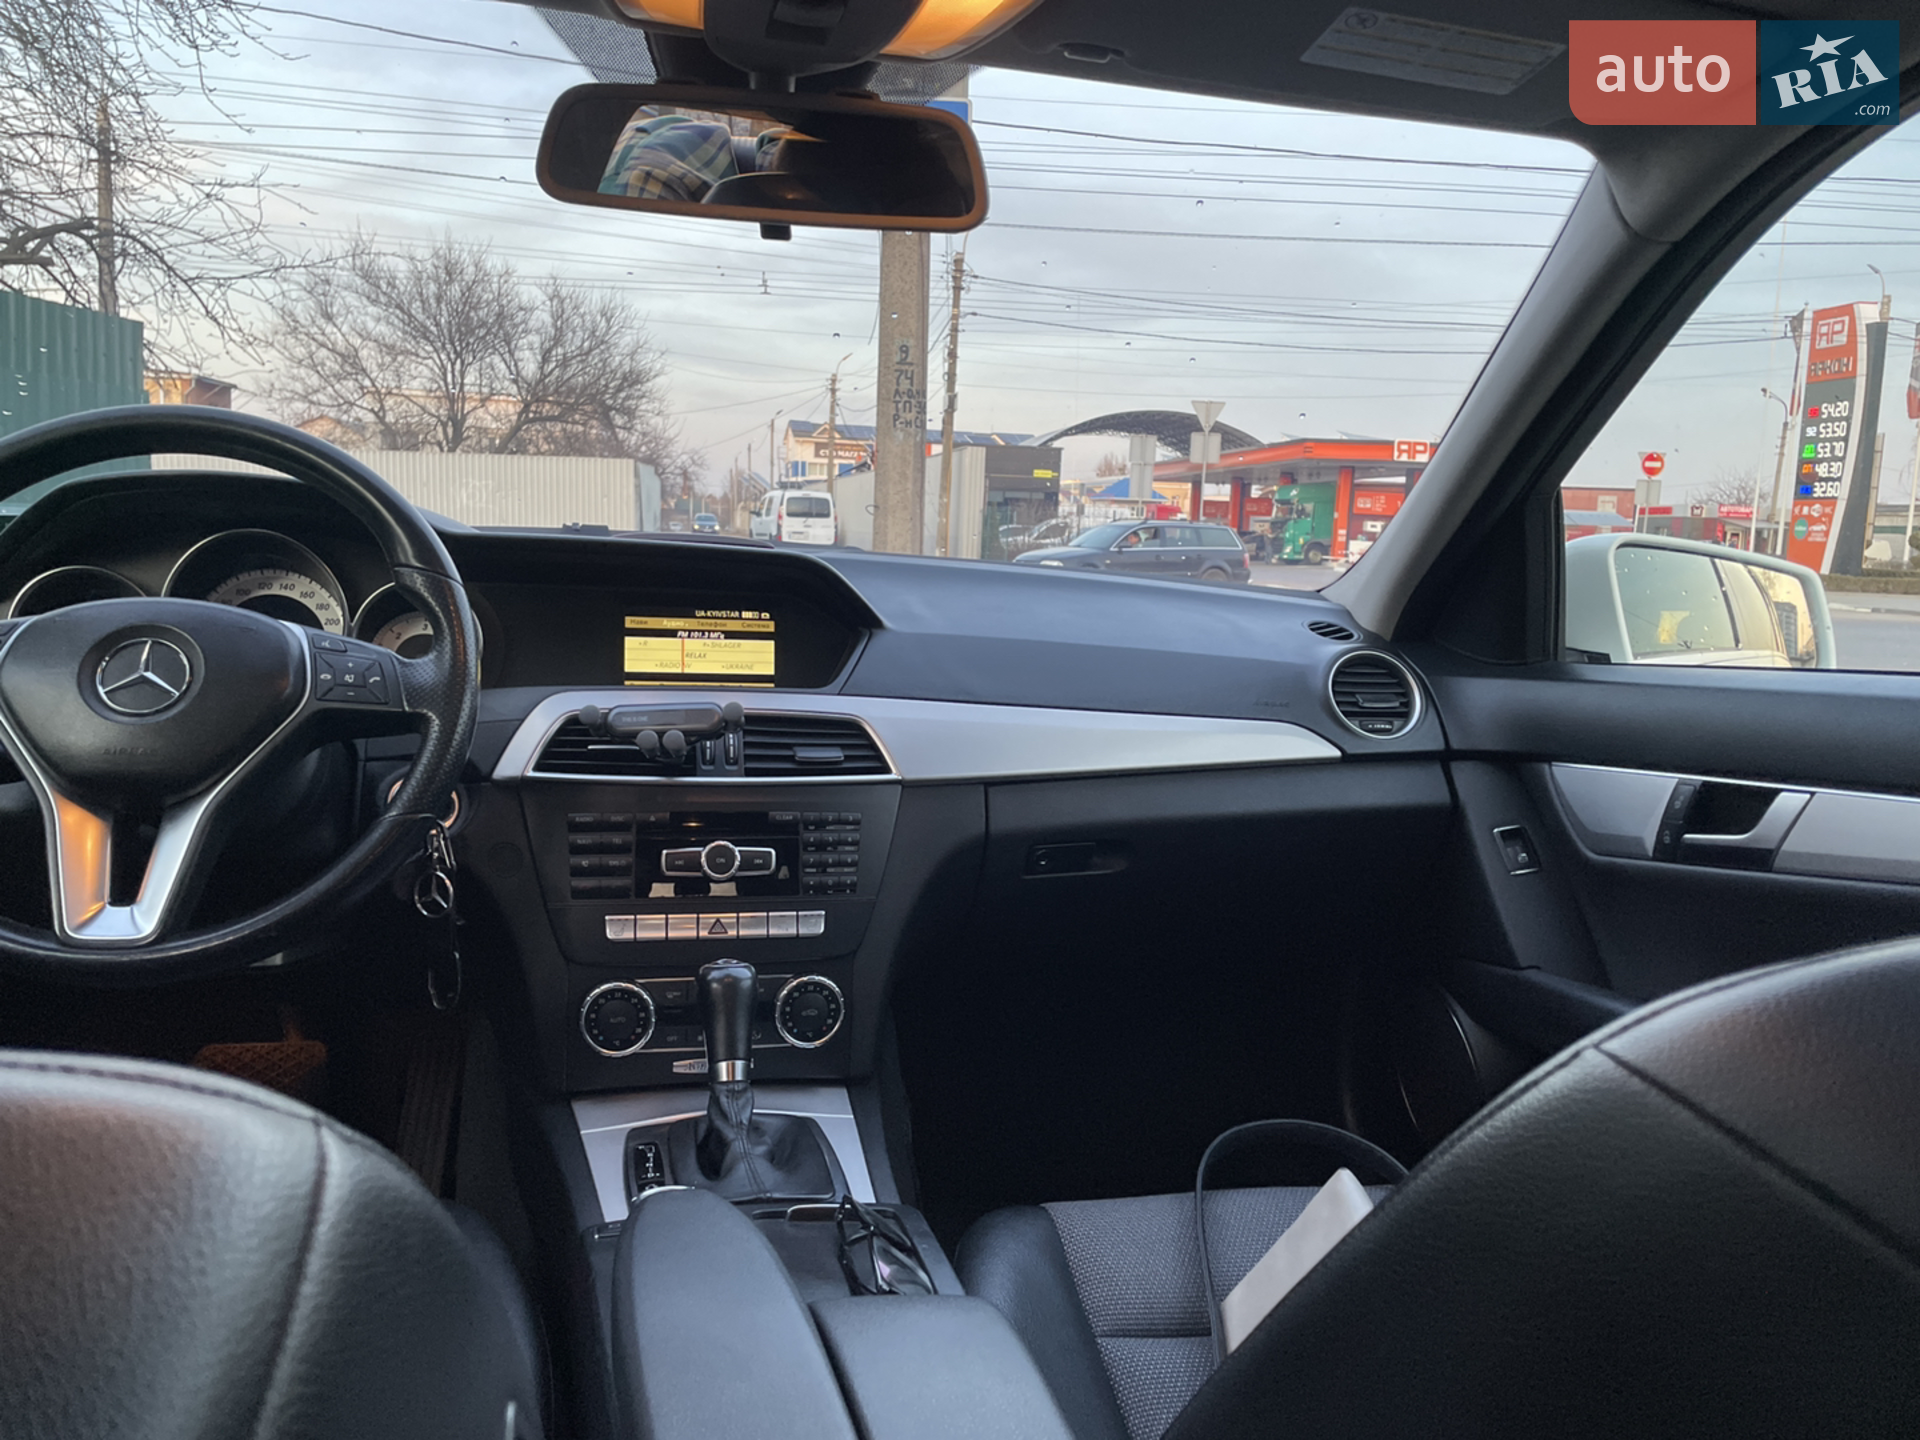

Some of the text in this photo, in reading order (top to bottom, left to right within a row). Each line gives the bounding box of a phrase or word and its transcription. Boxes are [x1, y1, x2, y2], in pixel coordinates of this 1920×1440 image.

[894, 369, 914, 388] 74
[1821, 401, 1850, 418] 54.20
[1819, 421, 1847, 438] 53.50
[1817, 441, 1845, 458] 53.70
[1812, 482, 1840, 498] 32.60
[258, 582, 273, 591] 120
[279, 583, 295, 591] 140
[299, 590, 315, 599] 160
[315, 602, 330, 611] 180
[695, 610, 740, 619] UA-KYIVSTAR
[324, 618, 340, 627] 200
[741, 622, 770, 630] Система
[677, 631, 688, 639] FM
[685, 651, 707, 660] RELAX
